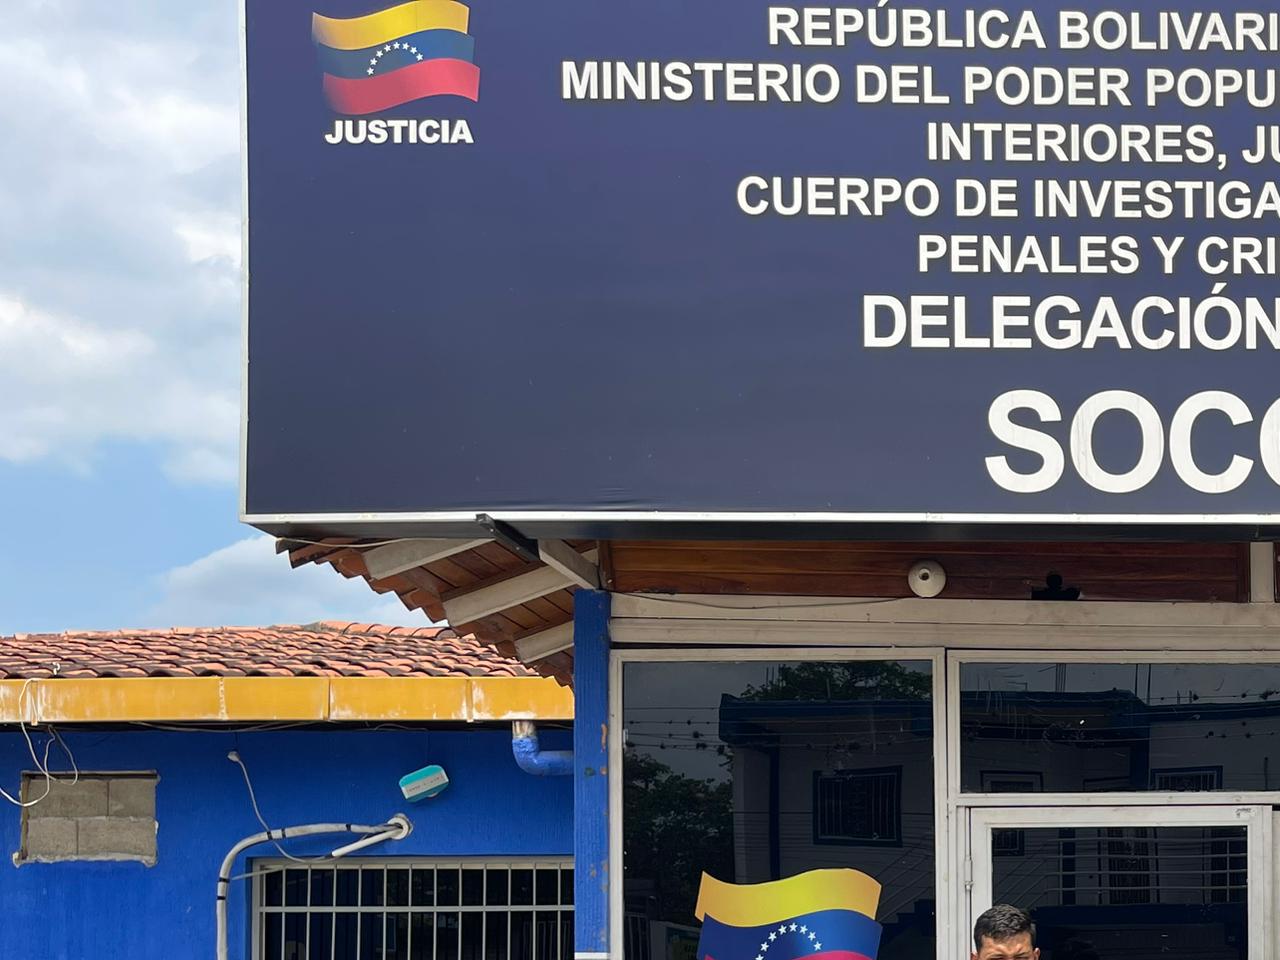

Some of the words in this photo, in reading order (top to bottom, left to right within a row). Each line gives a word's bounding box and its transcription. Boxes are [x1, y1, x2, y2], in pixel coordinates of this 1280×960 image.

[768, 0, 1046, 49] REPÚBLICA
[562, 61, 840, 103] MINISTERIO
[857, 64, 949, 104] DEL
[964, 65, 1132, 106] PODER
[324, 119, 474, 144] JUSTICIA
[928, 123, 1227, 170] INTERIORES,
[737, 176, 940, 217] CUERPO
[956, 178, 1019, 217] DE
[919, 234, 1140, 274] PENALES
[1152, 236, 1185, 274] Y
